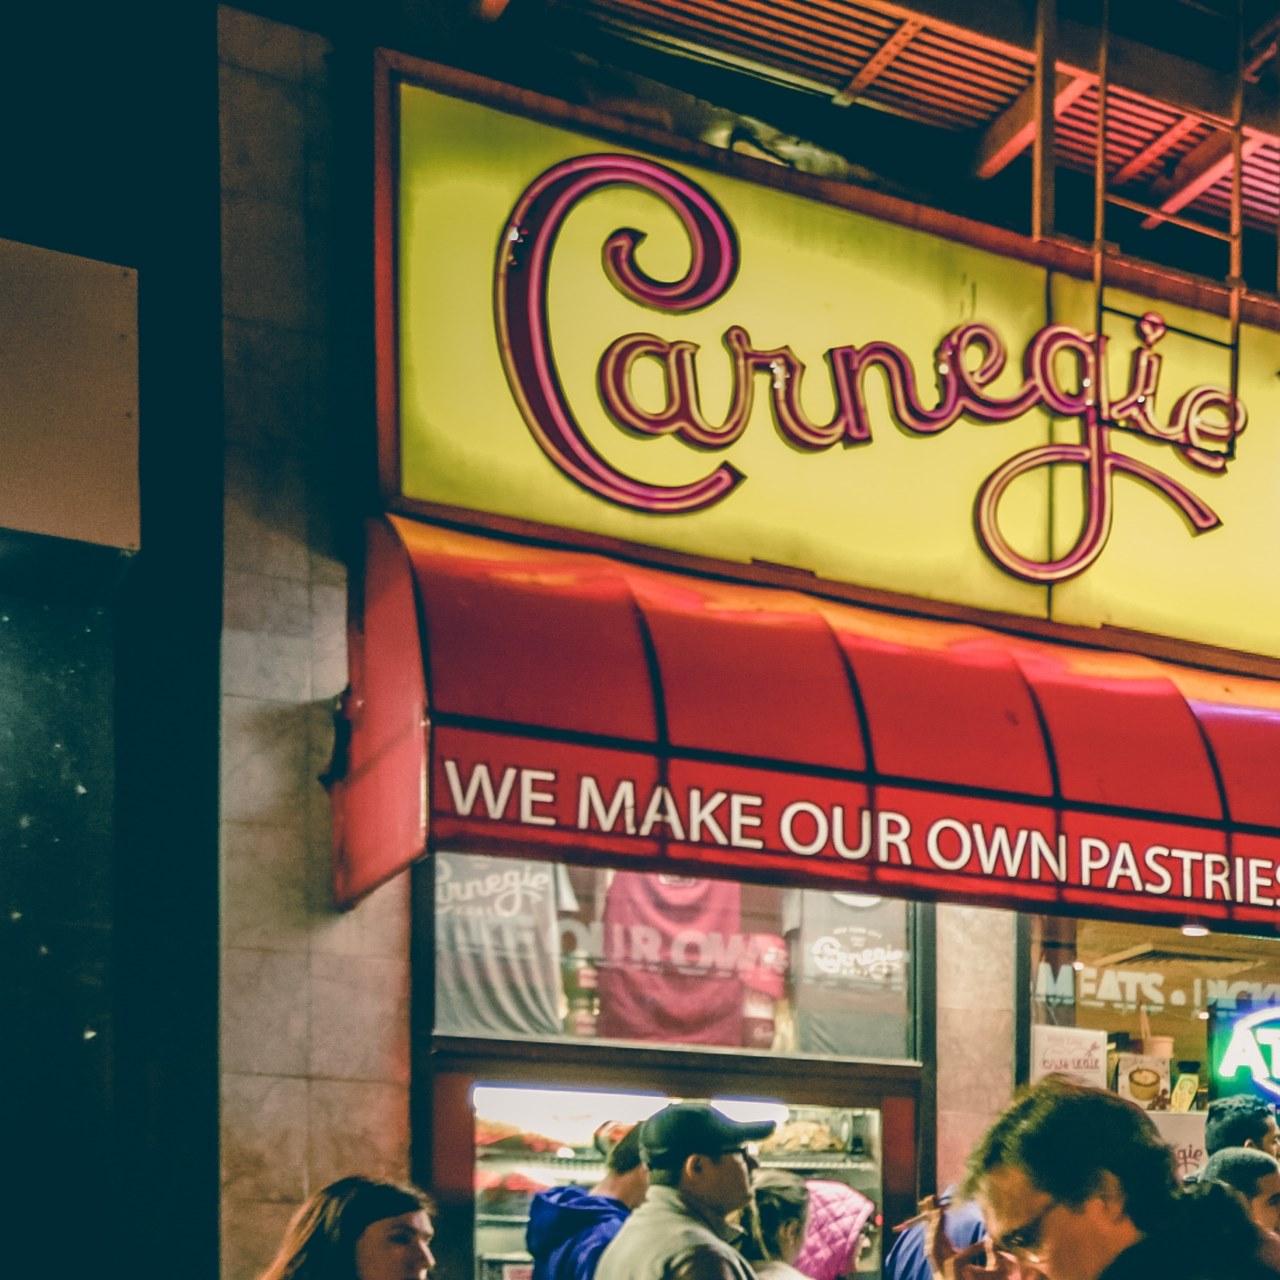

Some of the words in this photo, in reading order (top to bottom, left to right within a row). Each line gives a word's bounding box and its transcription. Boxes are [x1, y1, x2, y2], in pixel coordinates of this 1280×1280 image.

[493, 152, 1247, 583] Carnegie
[444, 759, 556, 826] WE
[577, 774, 764, 850] MAKE
[779, 800, 913, 866] OUR
[927, 816, 1069, 882] OWN
